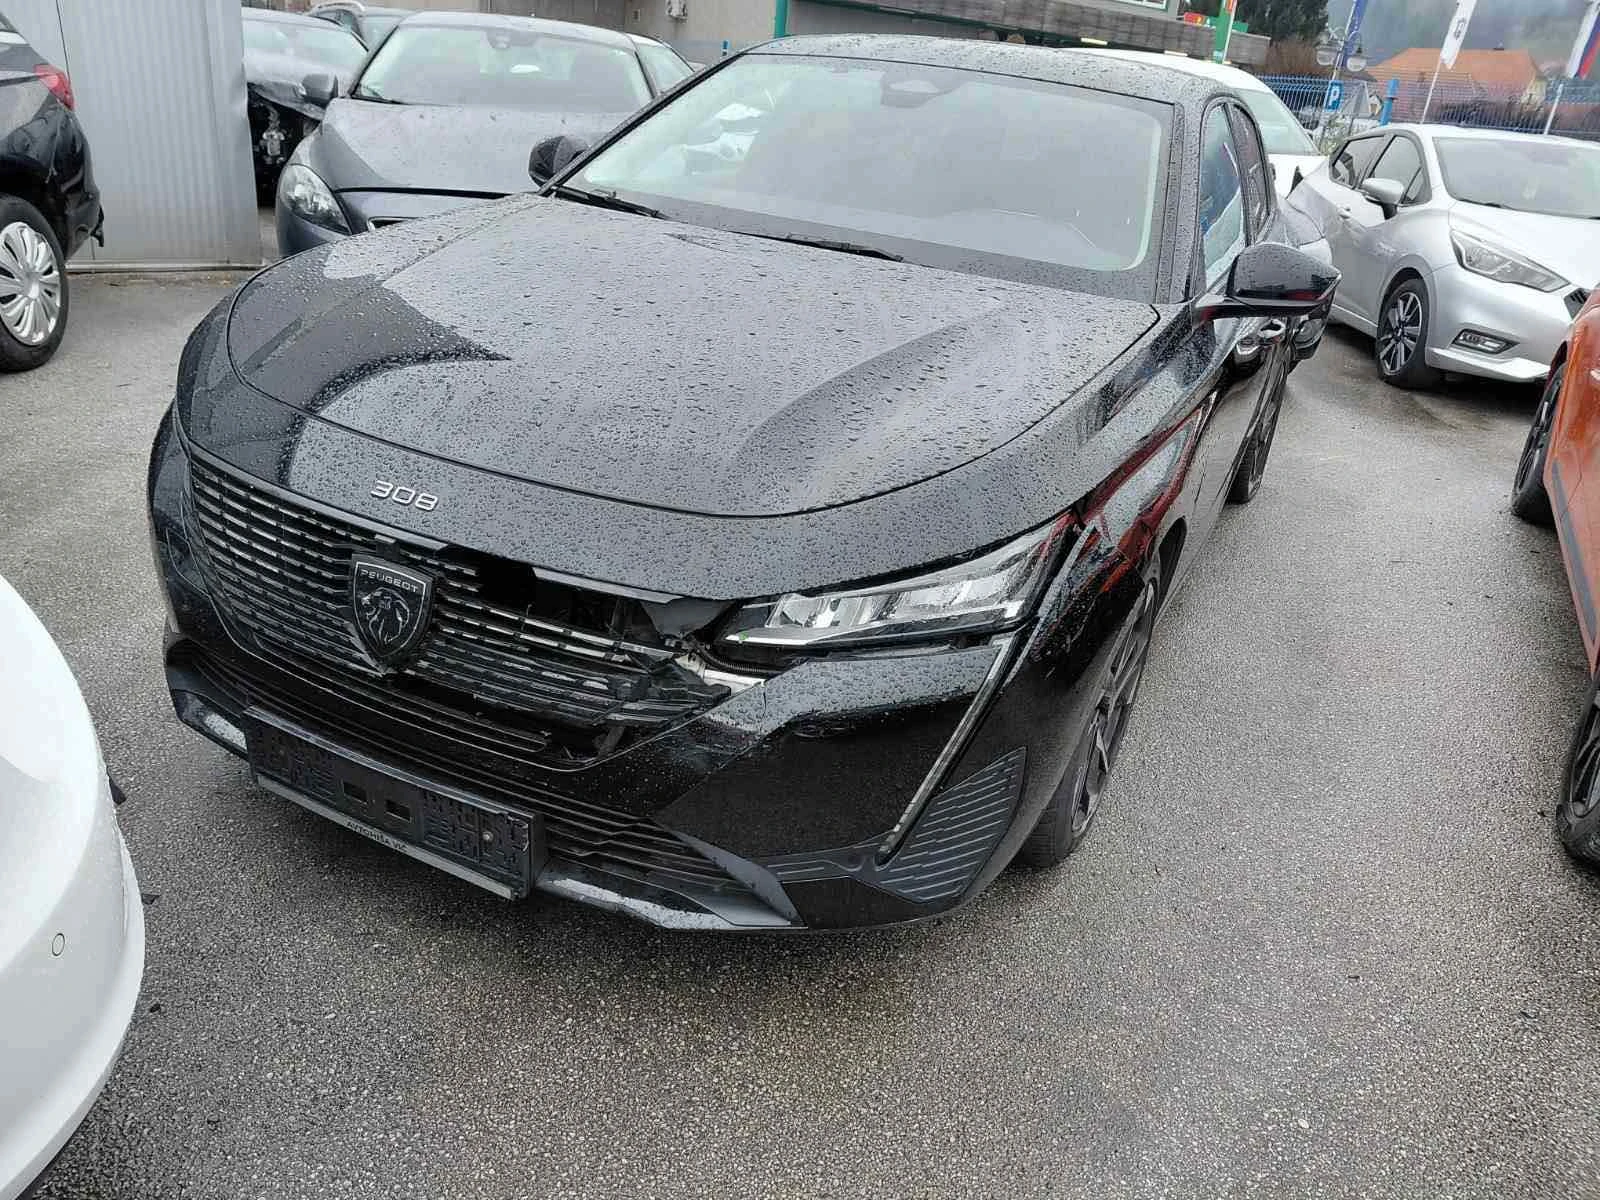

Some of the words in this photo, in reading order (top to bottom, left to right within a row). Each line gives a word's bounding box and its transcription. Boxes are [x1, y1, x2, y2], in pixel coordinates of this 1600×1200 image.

[1329, 86, 1340, 106] P
[371, 480, 438, 511] 308
[361, 569, 419, 593] PEUGEOT
